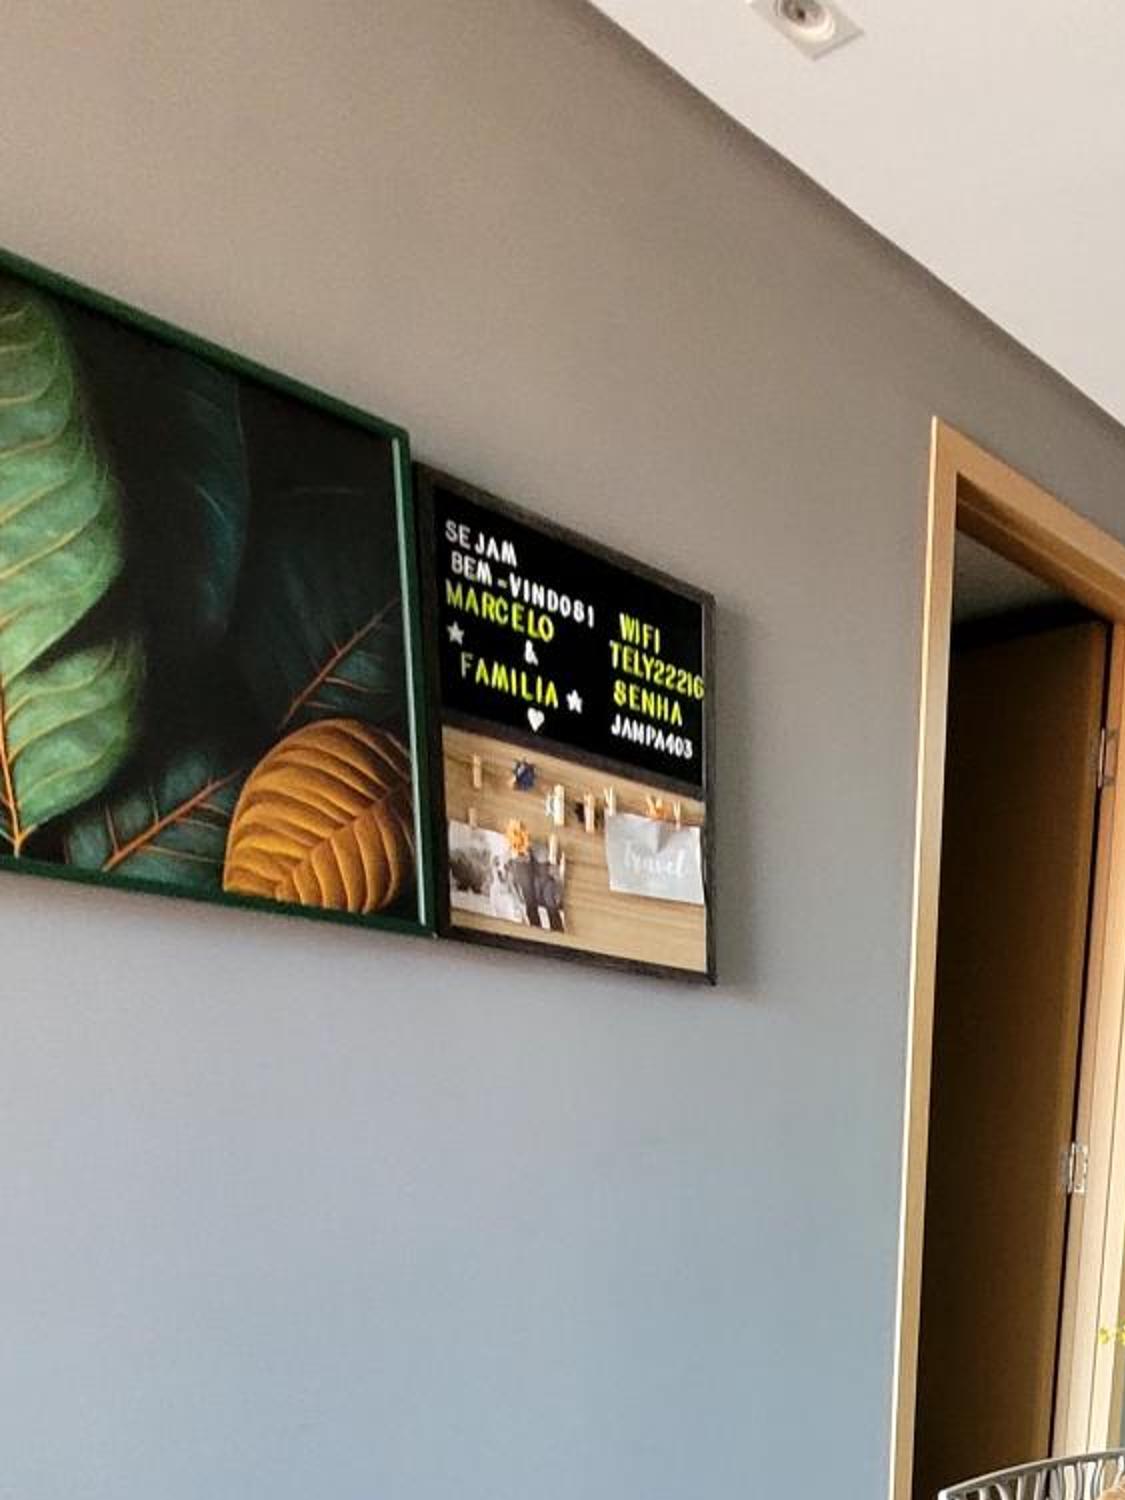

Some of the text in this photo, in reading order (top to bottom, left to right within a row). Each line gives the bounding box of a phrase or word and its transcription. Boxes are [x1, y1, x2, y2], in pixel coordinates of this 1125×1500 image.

[445, 520, 518, 568] SEJAM
[445, 579, 555, 643] MARCELO
[619, 612, 661, 655] WIFI
[524, 640, 539, 666] &
[461, 652, 559, 709] FAMILIA
